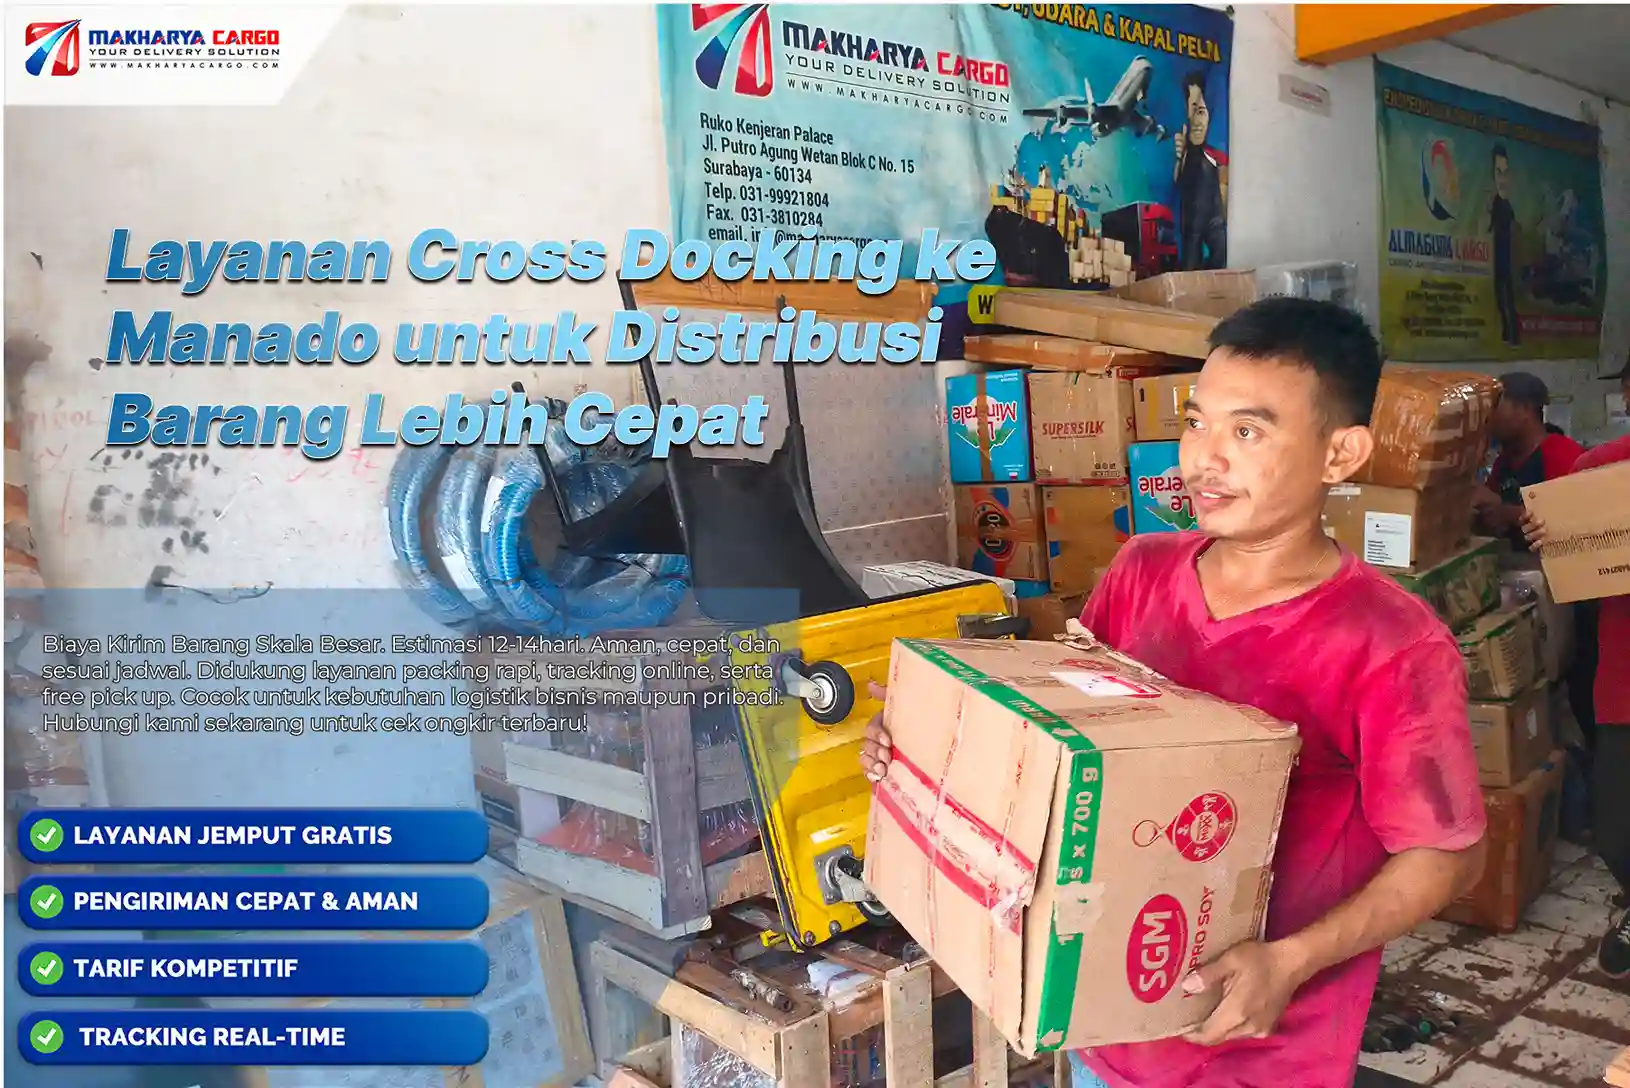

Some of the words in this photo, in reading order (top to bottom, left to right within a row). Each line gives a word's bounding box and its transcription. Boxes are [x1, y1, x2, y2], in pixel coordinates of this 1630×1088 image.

[1033, 4, 1099, 34] UDARA
[1103, 14, 1116, 37] &
[1119, 16, 1176, 52] KAPAL
[782, 20, 930, 72] MAKHARYA
[937, 51, 1009, 88] CARGO
[784, 53, 835, 74] YOUR
[843, 64, 926, 89] DELIVERY
[932, 79, 1010, 104] SOLUTION
[700, 113, 733, 133] Ruko
[736, 117, 790, 141] Kenjeran
[794, 126, 833, 145] Palace
[702, 139, 718, 153] Jl.
[721, 139, 757, 157] Putro
[760, 146, 798, 165] Agung
[802, 148, 838, 166] Wetan
[841, 152, 867, 169] Blok
[868, 157, 876, 171] C
[878, 157, 897, 172] No.
[900, 160, 915, 173] 15
[703, 158, 763, 180] Surabaya
[774, 168, 813, 183] 60134
[704, 183, 736, 201] Telp.
[739, 186, 829, 208] 031-99921804
[706, 204, 734, 222] Fax.
[741, 207, 823, 227] 031-3810284
[1041, 420, 1105, 436] SUPERSILK
[1170, 495, 1195, 518] Le
[1082, 767, 1098, 782] g
[1072, 791, 1093, 836] 700
[1198, 885, 1217, 926] SOY
[1139, 911, 1172, 992] SGM
